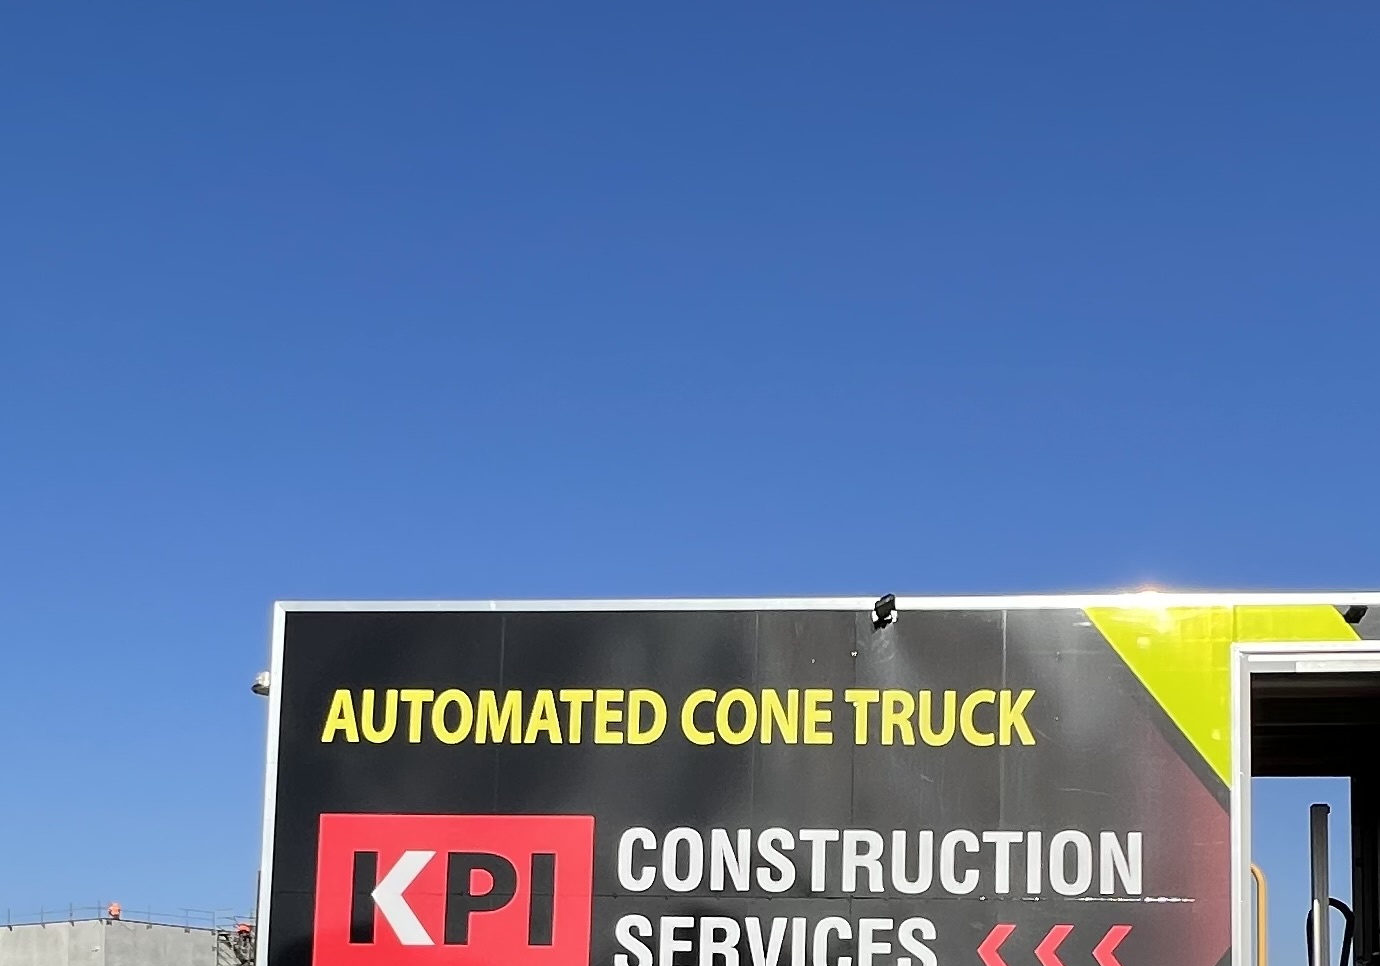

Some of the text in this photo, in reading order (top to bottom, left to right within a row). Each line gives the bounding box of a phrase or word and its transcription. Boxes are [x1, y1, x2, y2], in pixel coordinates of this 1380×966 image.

[321, 688, 1037, 747] AUTOMATED CONE TRUCK
[616, 826, 1144, 896] CONSTRUCTION
[348, 850, 558, 948] KPI
